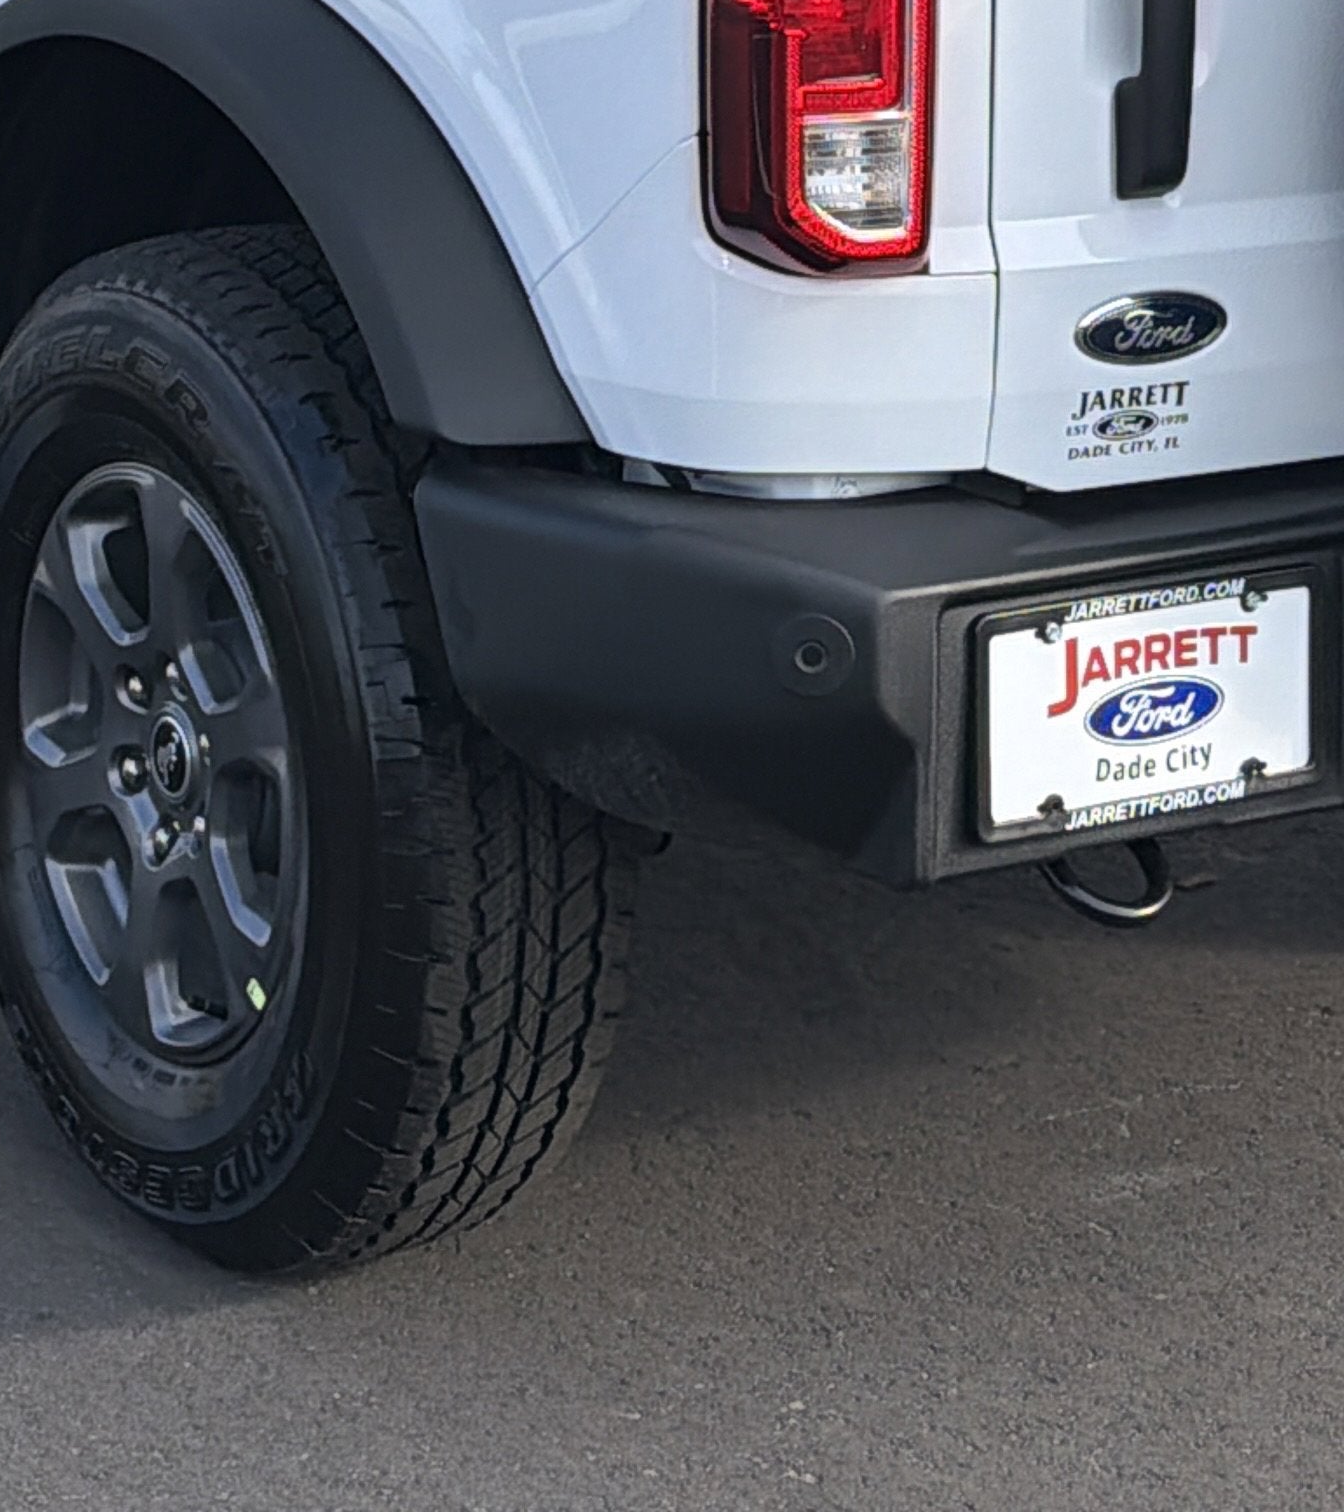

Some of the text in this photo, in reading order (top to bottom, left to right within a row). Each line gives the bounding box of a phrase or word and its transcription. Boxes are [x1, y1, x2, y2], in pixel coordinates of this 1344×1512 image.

[1115, 310, 1196, 351] Ford
[1071, 380, 1190, 421] JARRETT
[1067, 444, 1112, 461] DADE
[1063, 578, 1246, 623] JARRETTFORD.COM
[1048, 625, 1257, 717] JARRETT
[1111, 686, 1197, 738] Ford
[1095, 743, 1213, 782] Dade City
[1064, 780, 1246, 830] JARRETTFORD.COM
